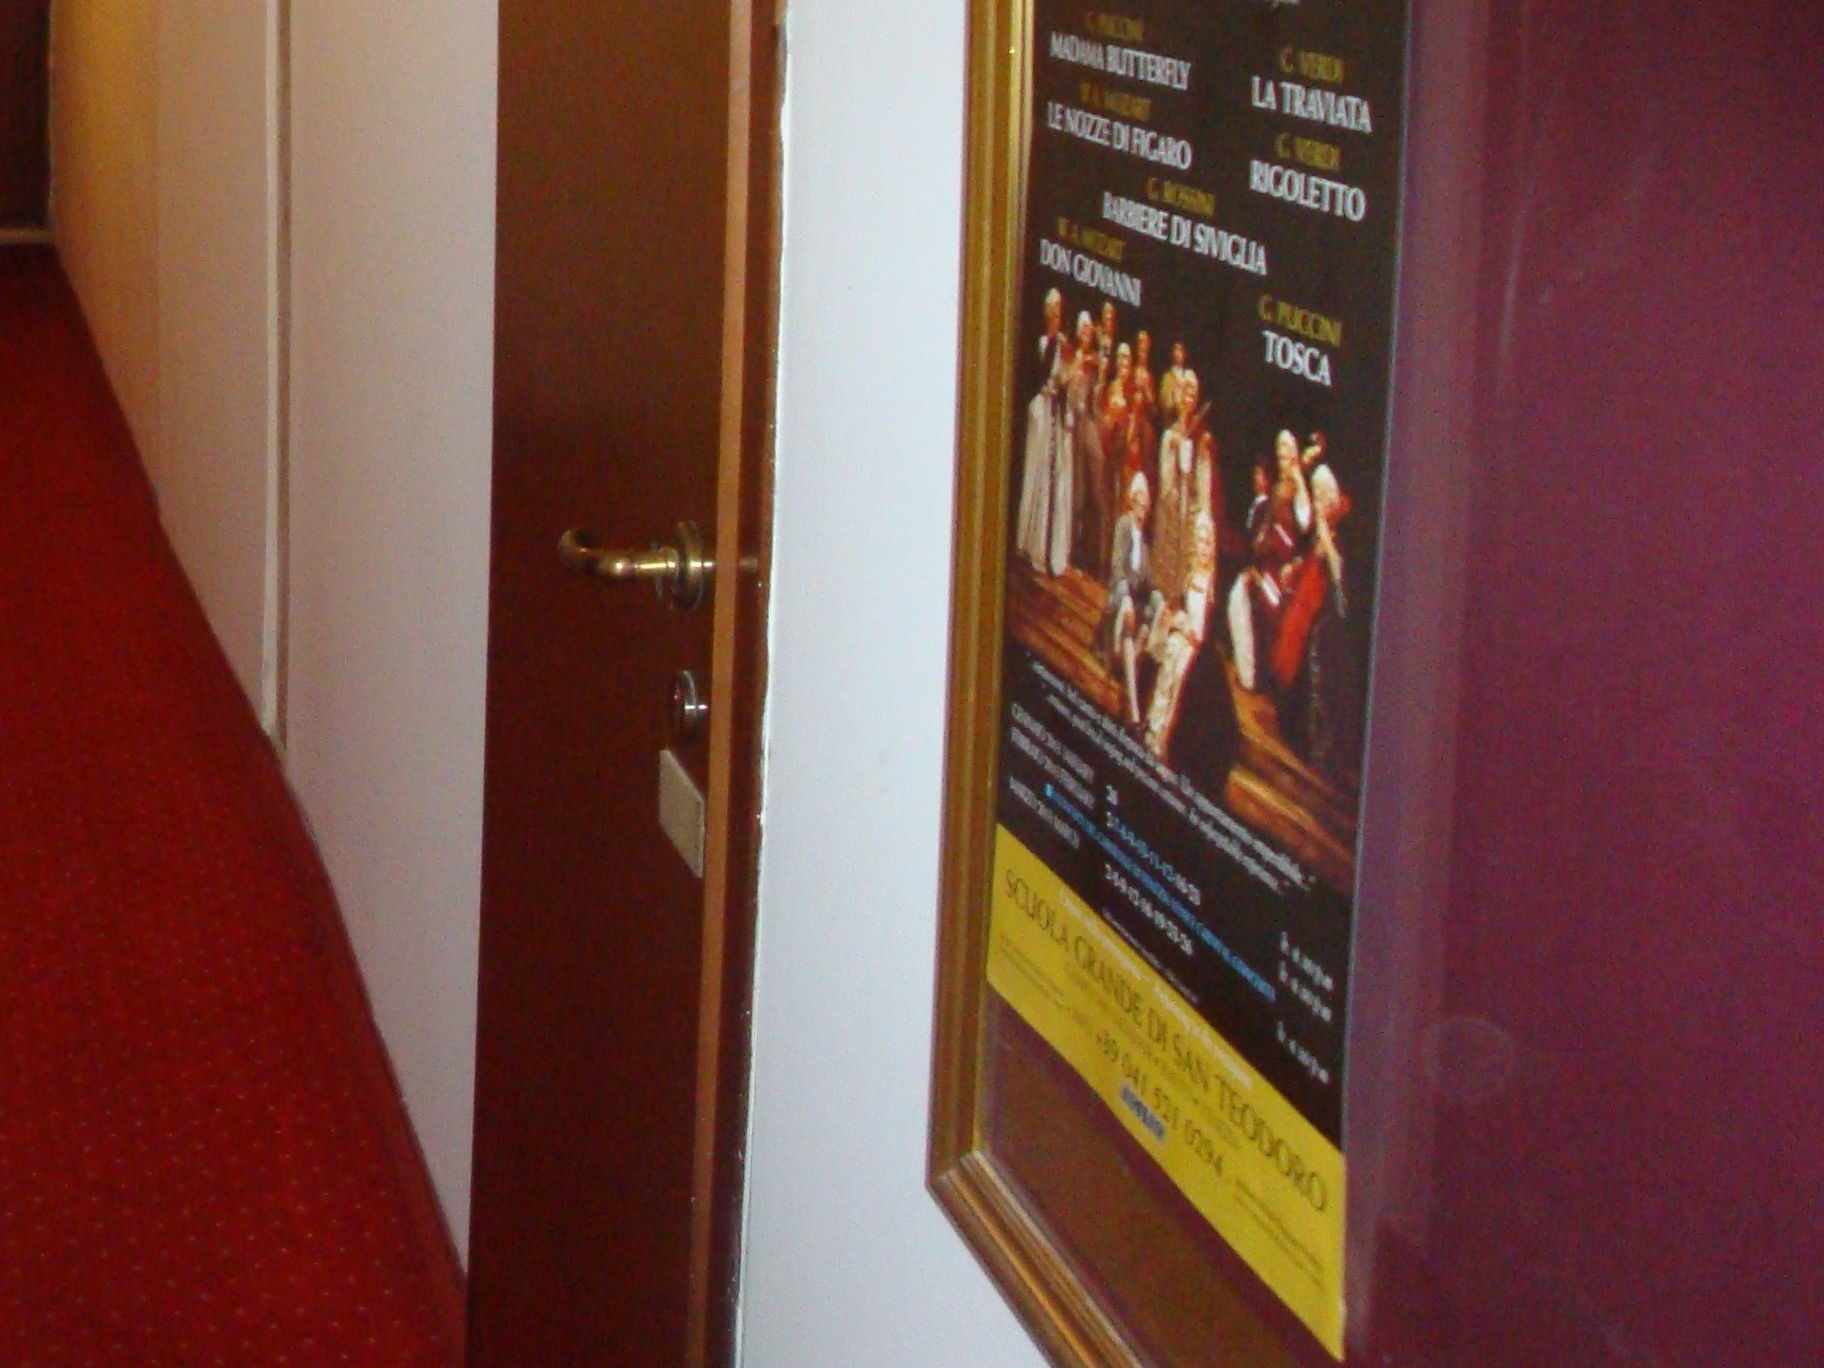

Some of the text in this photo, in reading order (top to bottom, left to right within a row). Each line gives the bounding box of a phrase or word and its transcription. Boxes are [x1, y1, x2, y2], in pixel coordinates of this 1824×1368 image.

[1048, 102, 1192, 170] LE NOZZE DI FIGARO
[1251, 75, 1373, 134] LA TRAVIATA
[1249, 159, 1366, 222] RIGOLETTO
[1103, 190, 1169, 241] BARBIERE
[1170, 215, 1191, 248] DI
[1194, 222, 1268, 276] SIVIGLIA
[1040, 238, 1072, 275] DON
[1073, 253, 1142, 308] GIOVANNI
[1262, 329, 1332, 386] TOSCA
[1005, 869, 1068, 952] SCUOLA
[1214, 1074, 1326, 1212] TEODORO
